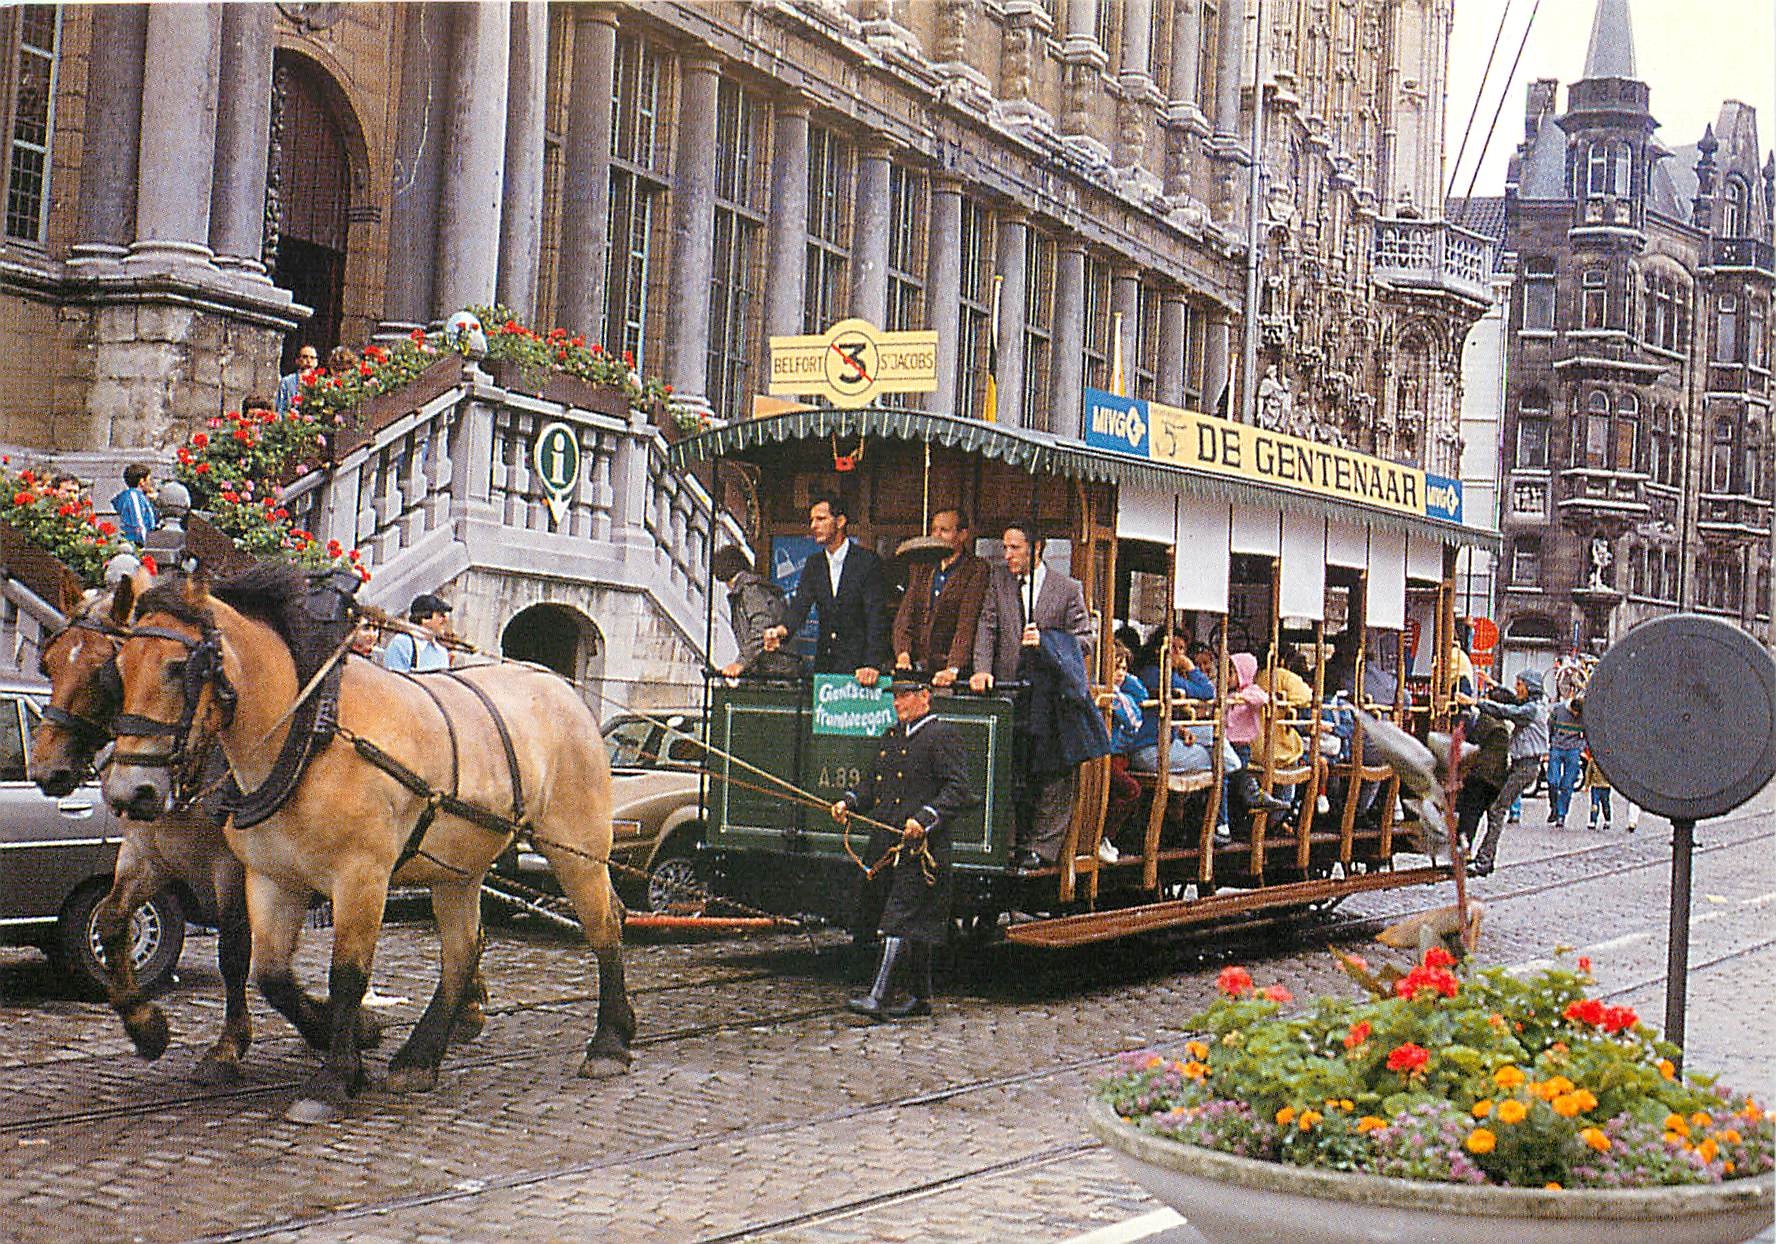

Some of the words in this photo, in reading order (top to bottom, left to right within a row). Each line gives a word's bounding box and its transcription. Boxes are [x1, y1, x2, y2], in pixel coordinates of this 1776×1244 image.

[774, 356, 823, 373] BELFORT
[838, 342, 866, 384] 3
[1092, 405, 1126, 438] MIVG
[1197, 422, 1240, 468] DE
[1256, 437, 1417, 507] GENTENAAR
